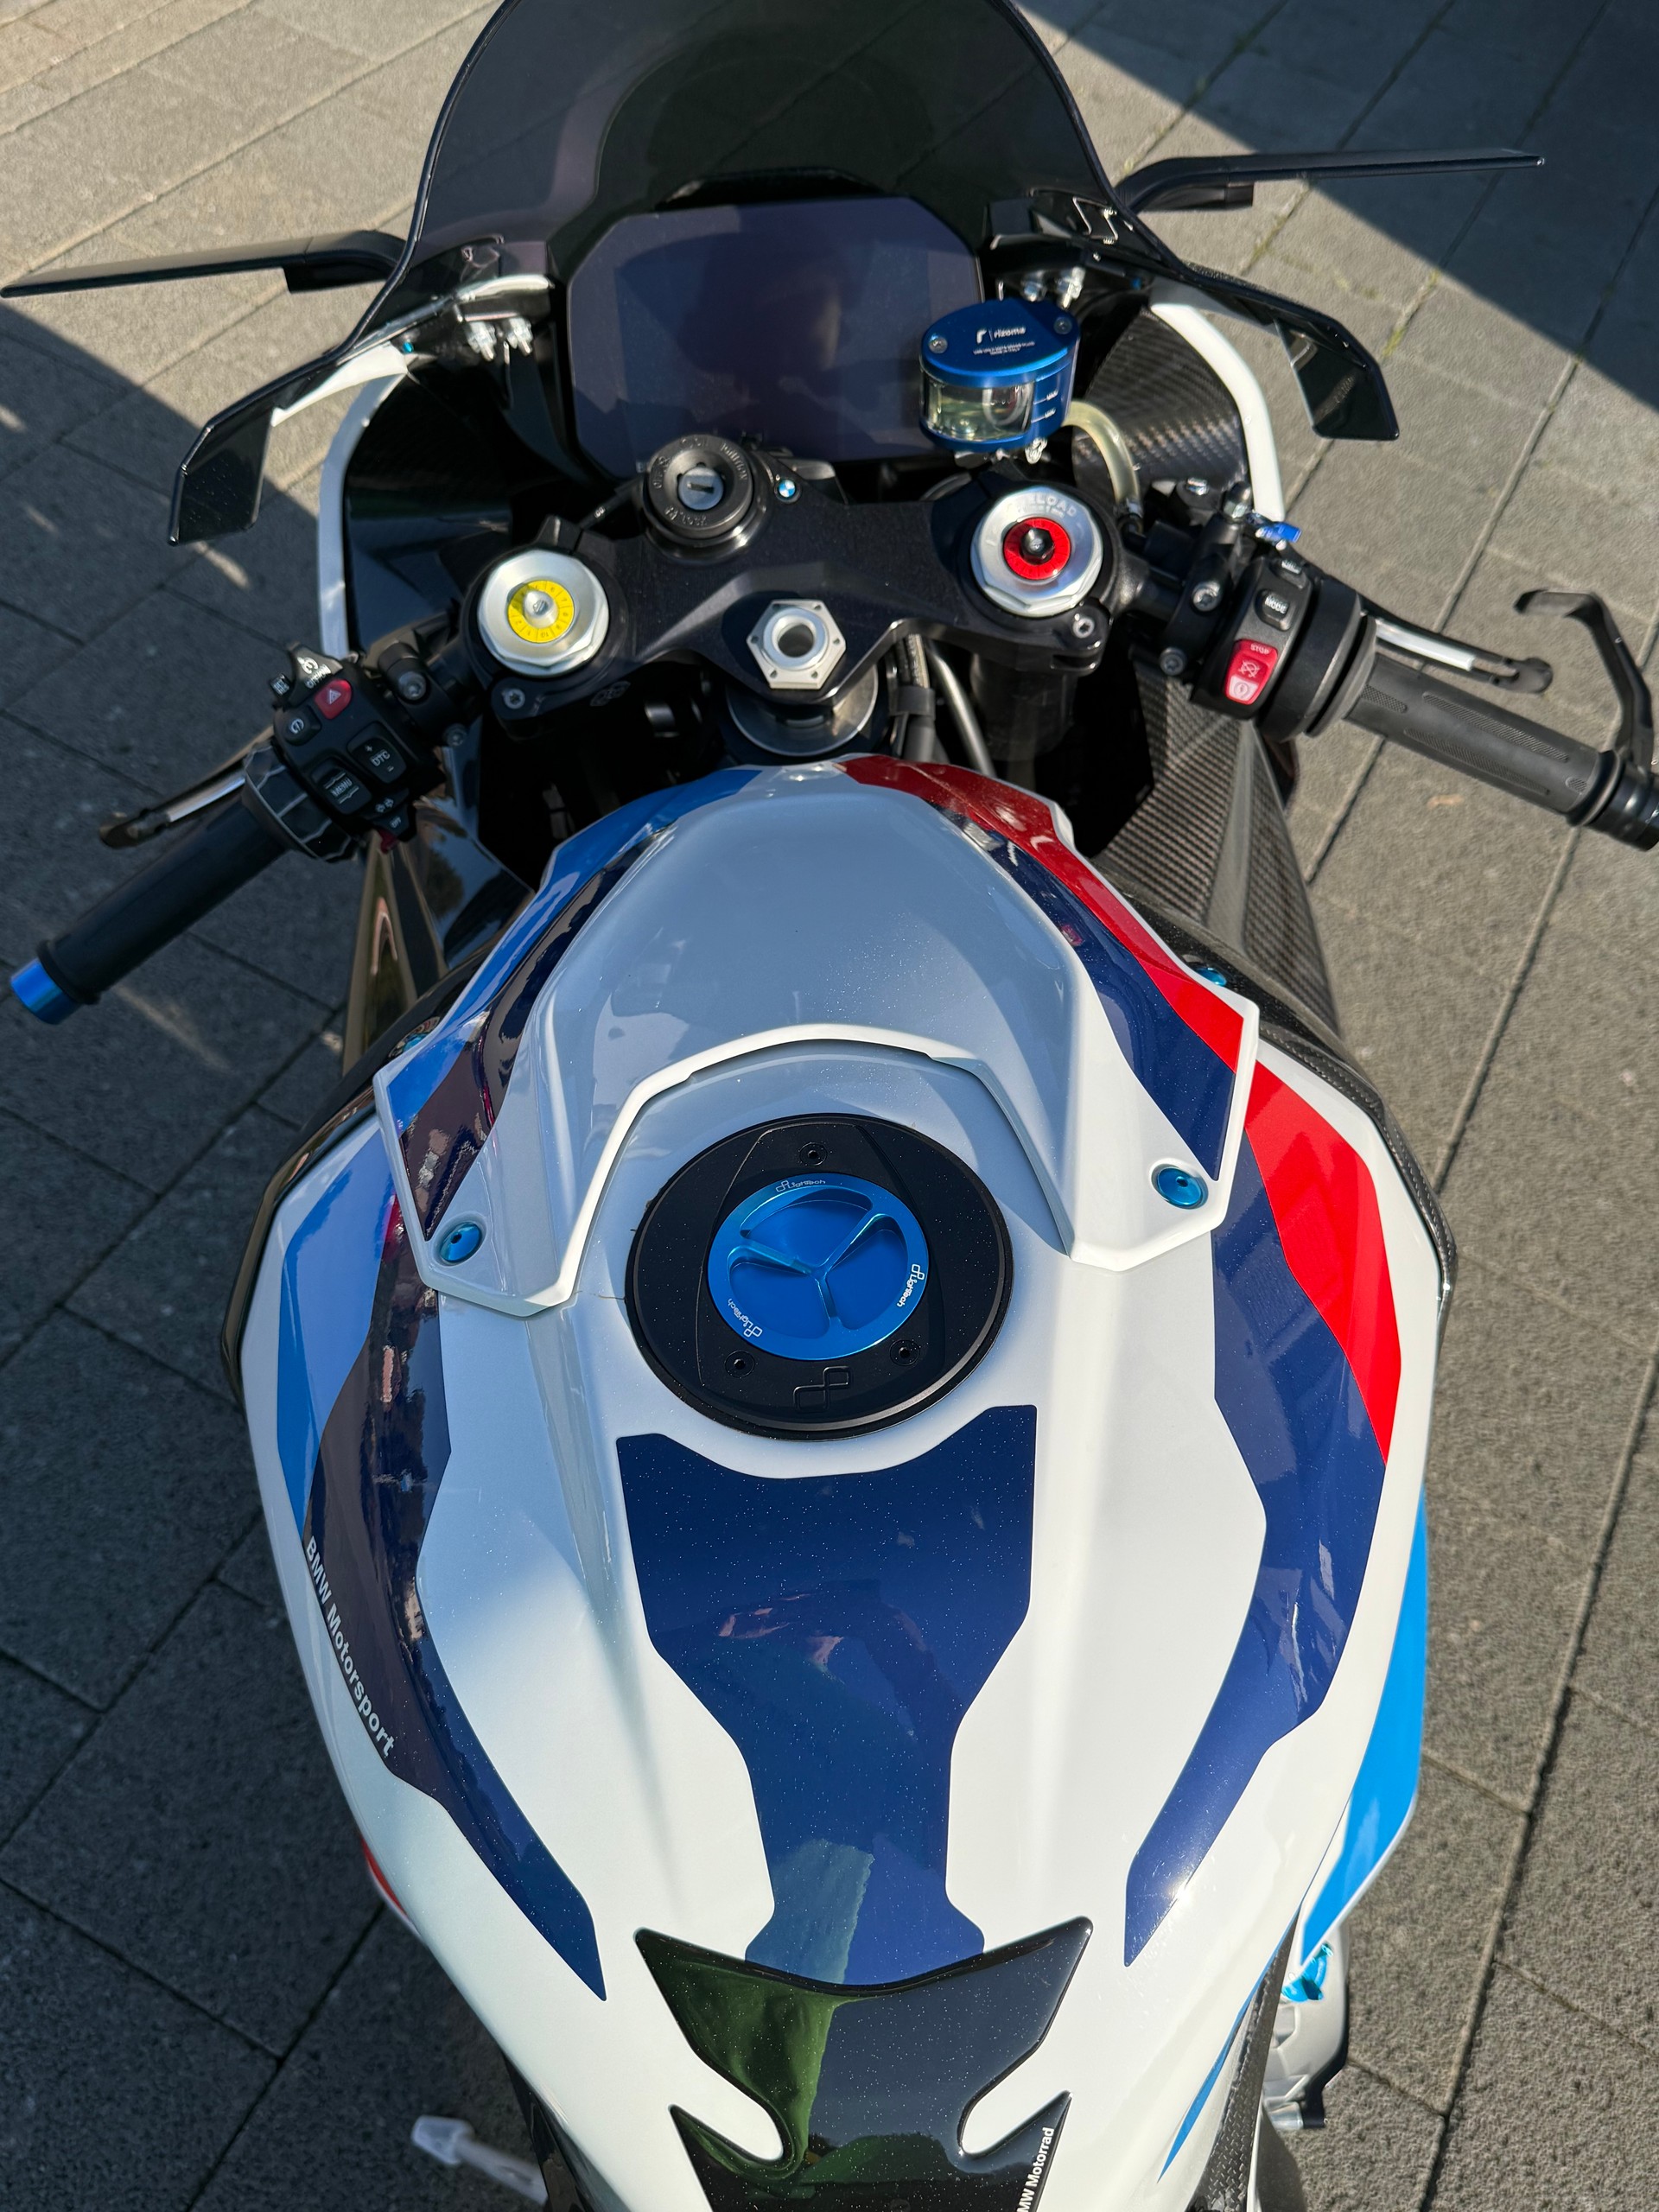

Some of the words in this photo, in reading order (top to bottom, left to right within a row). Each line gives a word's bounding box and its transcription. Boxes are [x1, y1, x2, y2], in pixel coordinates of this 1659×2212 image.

[994, 327, 1026, 339] rizoma
[1249, 642, 1271, 655] STOP
[370, 749, 391, 767] DTC
[330, 777, 353, 797] MENU
[306, 1535, 332, 1605] BMW
[327, 1603, 396, 1758] Motorsport
[1025, 2126, 1055, 2187] Motorrad
[1016, 2188, 1035, 2212] MW
